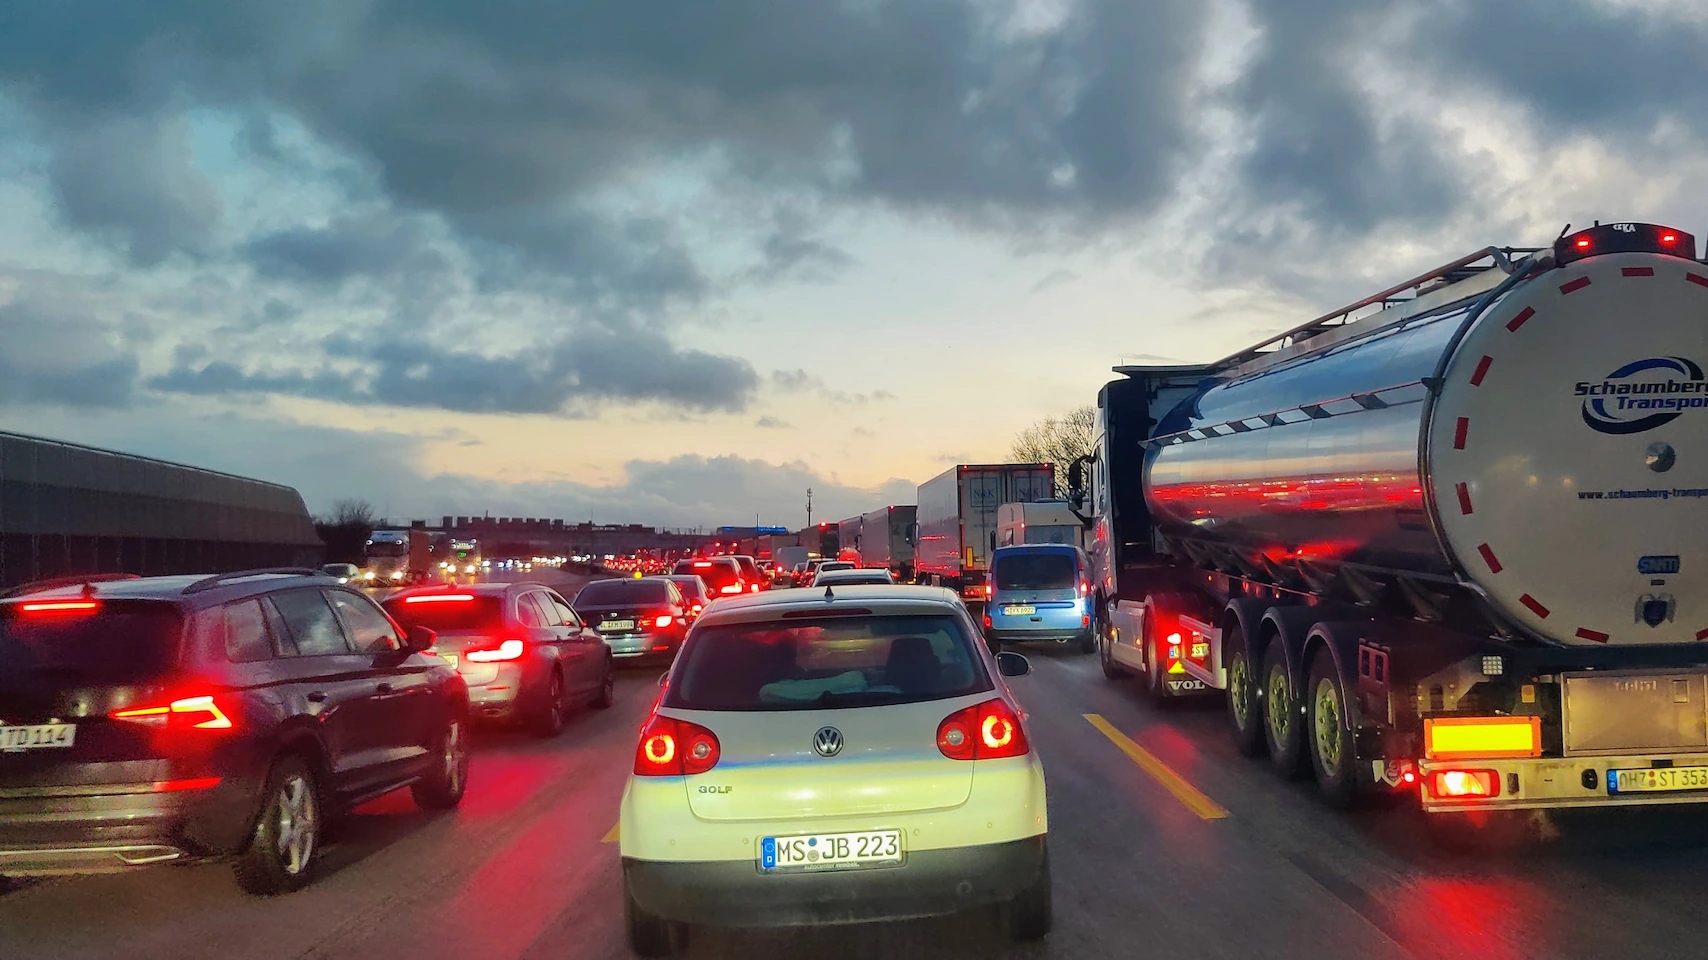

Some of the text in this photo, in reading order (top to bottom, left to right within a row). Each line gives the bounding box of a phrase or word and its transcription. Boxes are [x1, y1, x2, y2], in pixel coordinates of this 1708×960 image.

[1659, 771, 1677, 787] ST
[1681, 769, 1708, 786] 353
[698, 785, 733, 794] GOLF
[777, 839, 806, 862] MS
[822, 837, 850, 859] JB
[857, 834, 897, 858] 223
